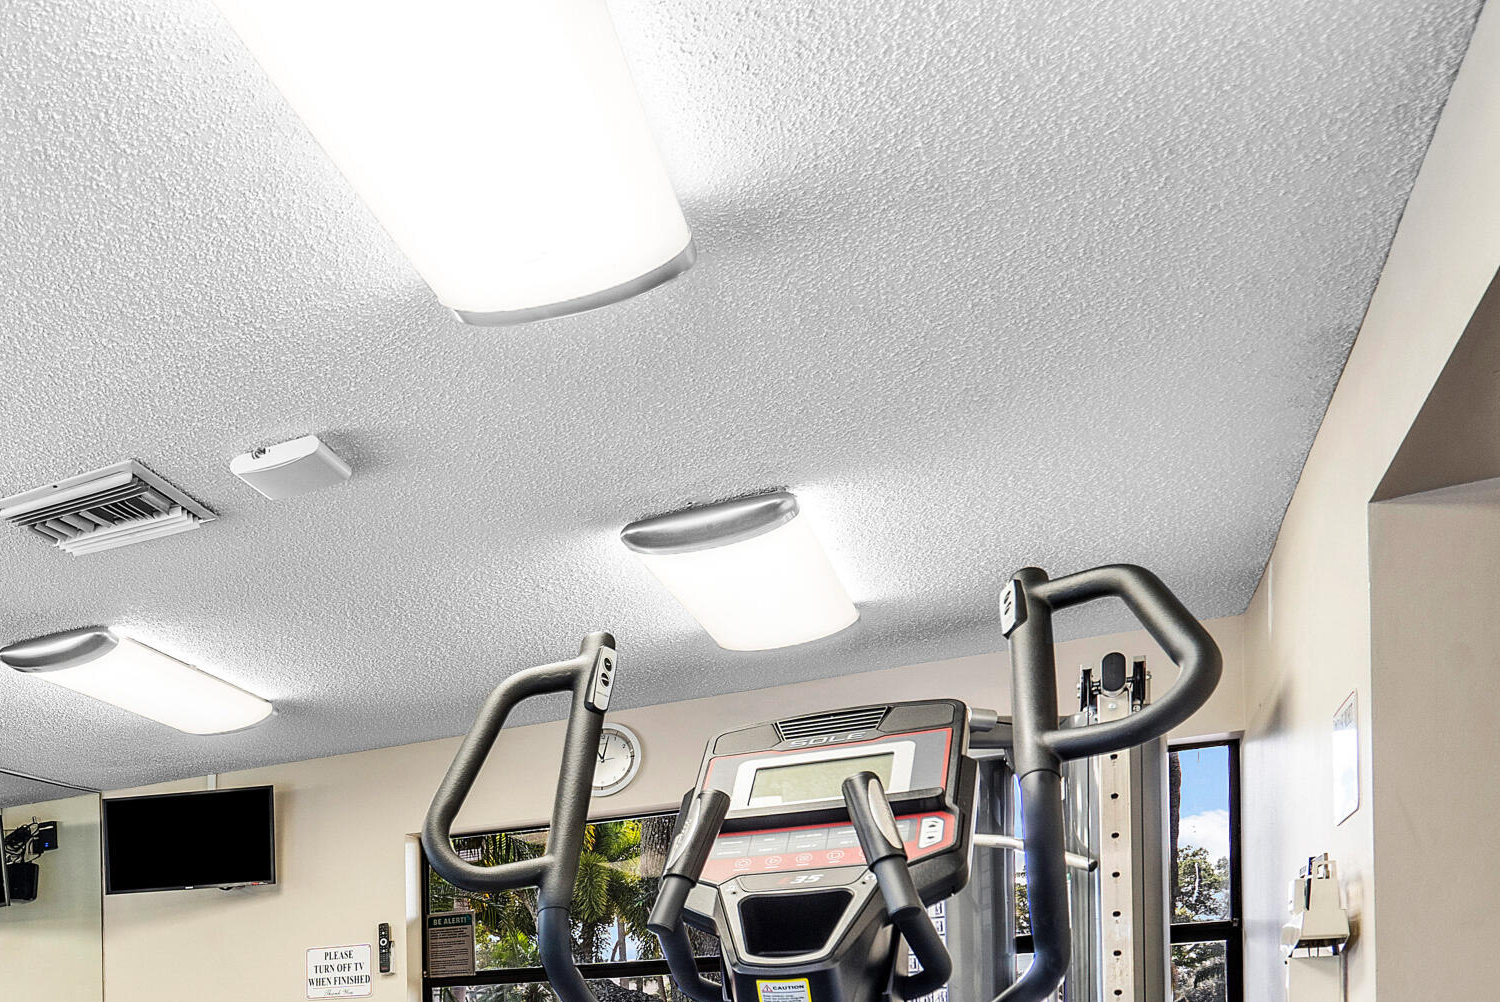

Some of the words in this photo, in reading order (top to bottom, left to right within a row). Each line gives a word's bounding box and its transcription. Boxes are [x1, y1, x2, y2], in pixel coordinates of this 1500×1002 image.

[789, 731, 867, 748] SOLE
[324, 950, 354, 960] PLEASE
[314, 964, 335, 974] TURN
[336, 963, 352, 972] OFF
[354, 962, 365, 971] TV
[308, 977, 332, 987] WHEN
[333, 974, 371, 986] FINISHED
